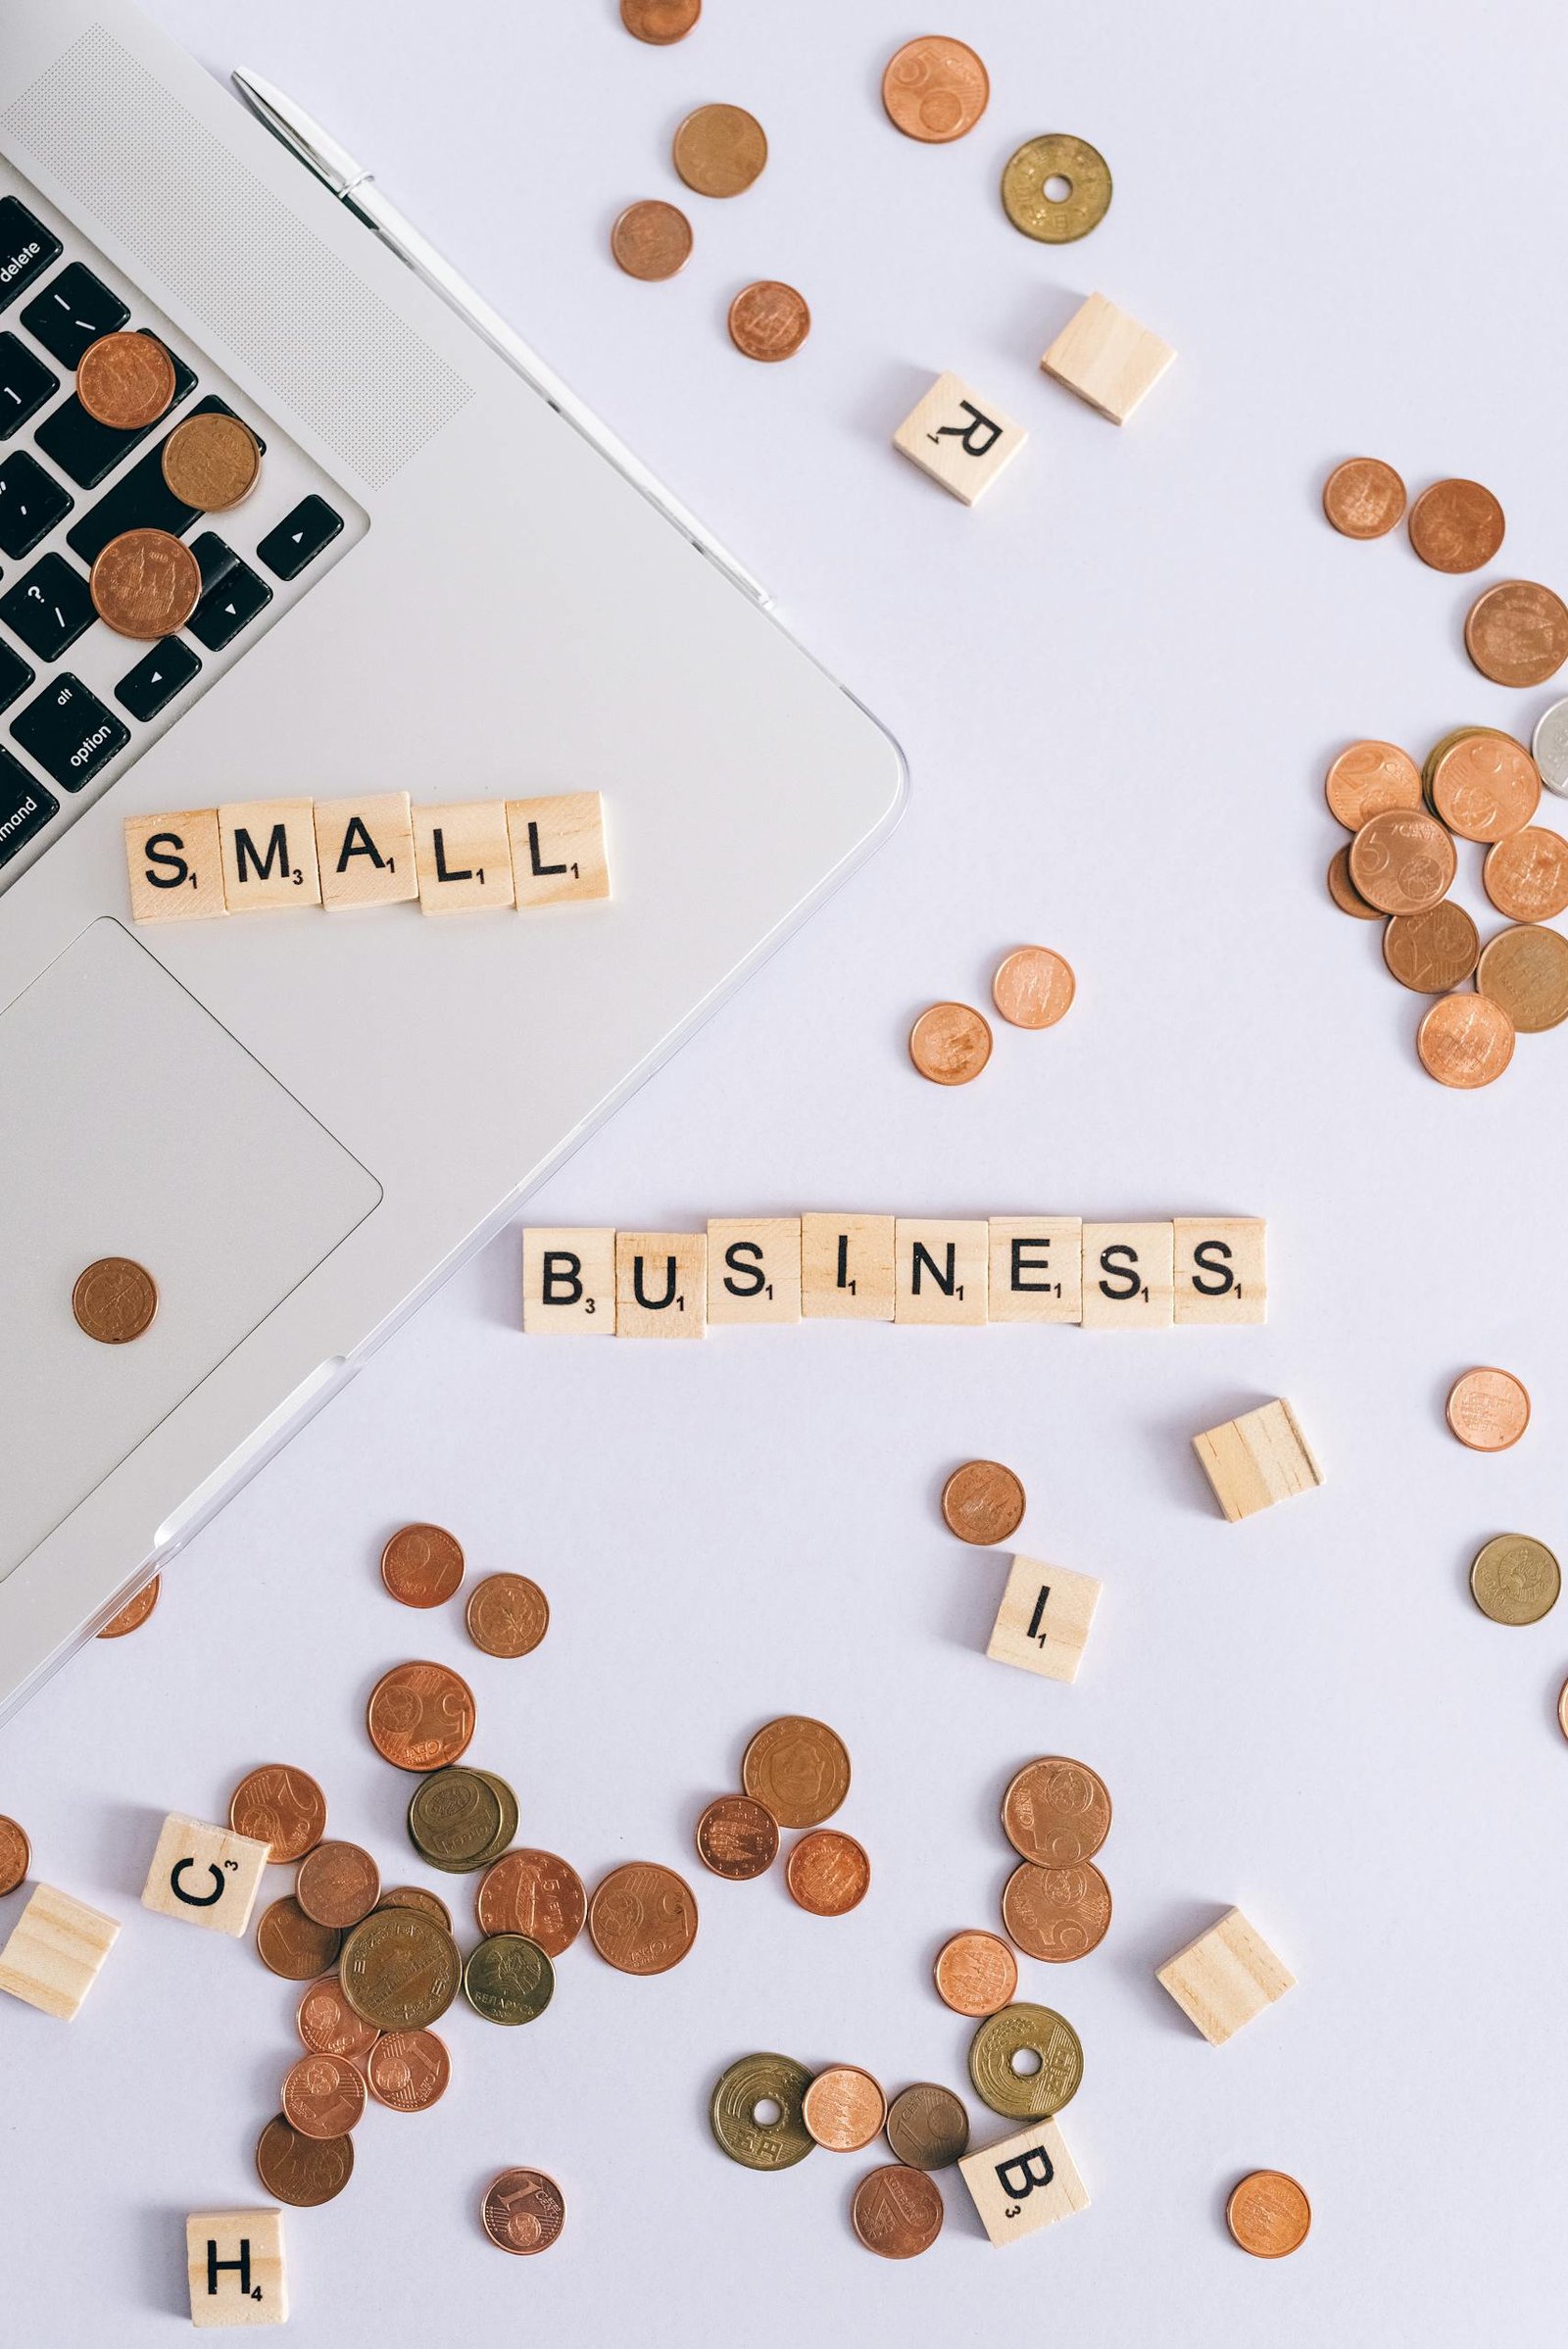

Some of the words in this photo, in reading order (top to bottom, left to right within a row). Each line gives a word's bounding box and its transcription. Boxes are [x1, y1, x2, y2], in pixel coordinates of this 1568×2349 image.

[0, 242, 40, 282] delete
[927, 433, 939, 444] 1
[936, 400, 1004, 457] R
[27, 585, 46, 604] ?
[57, 688, 73, 706] alt
[70, 725, 112, 767] option
[144, 816, 567, 889] SMALL
[1360, 832, 1391, 876] 5
[1393, 935, 1434, 984] 2
[542, 1235, 1235, 1310] BUSINESS
[1026, 1585, 1051, 1639] I
[1038, 1633, 1047, 1649] 1
[435, 1688, 467, 1749] 5
[404, 1738, 441, 1759] CENT
[270, 1771, 318, 1817] 2
[223, 1859, 239, 1872] 3
[1029, 1828, 1082, 1863] 5
[170, 1857, 225, 1907] C
[541, 1879, 561, 1891] 5
[1035, 1918, 1090, 1952] 5
[474, 1990, 535, 2016] БЕЛАРУСЬ
[405, 2038, 442, 2078] 1
[895, 2118, 932, 2162] 1
[994, 2144, 1054, 2200] B
[497, 2178, 543, 2212] 1
[1004, 2205, 1021, 2219] 3
[207, 2238, 251, 2295] H
[250, 2285, 264, 2302] 4
